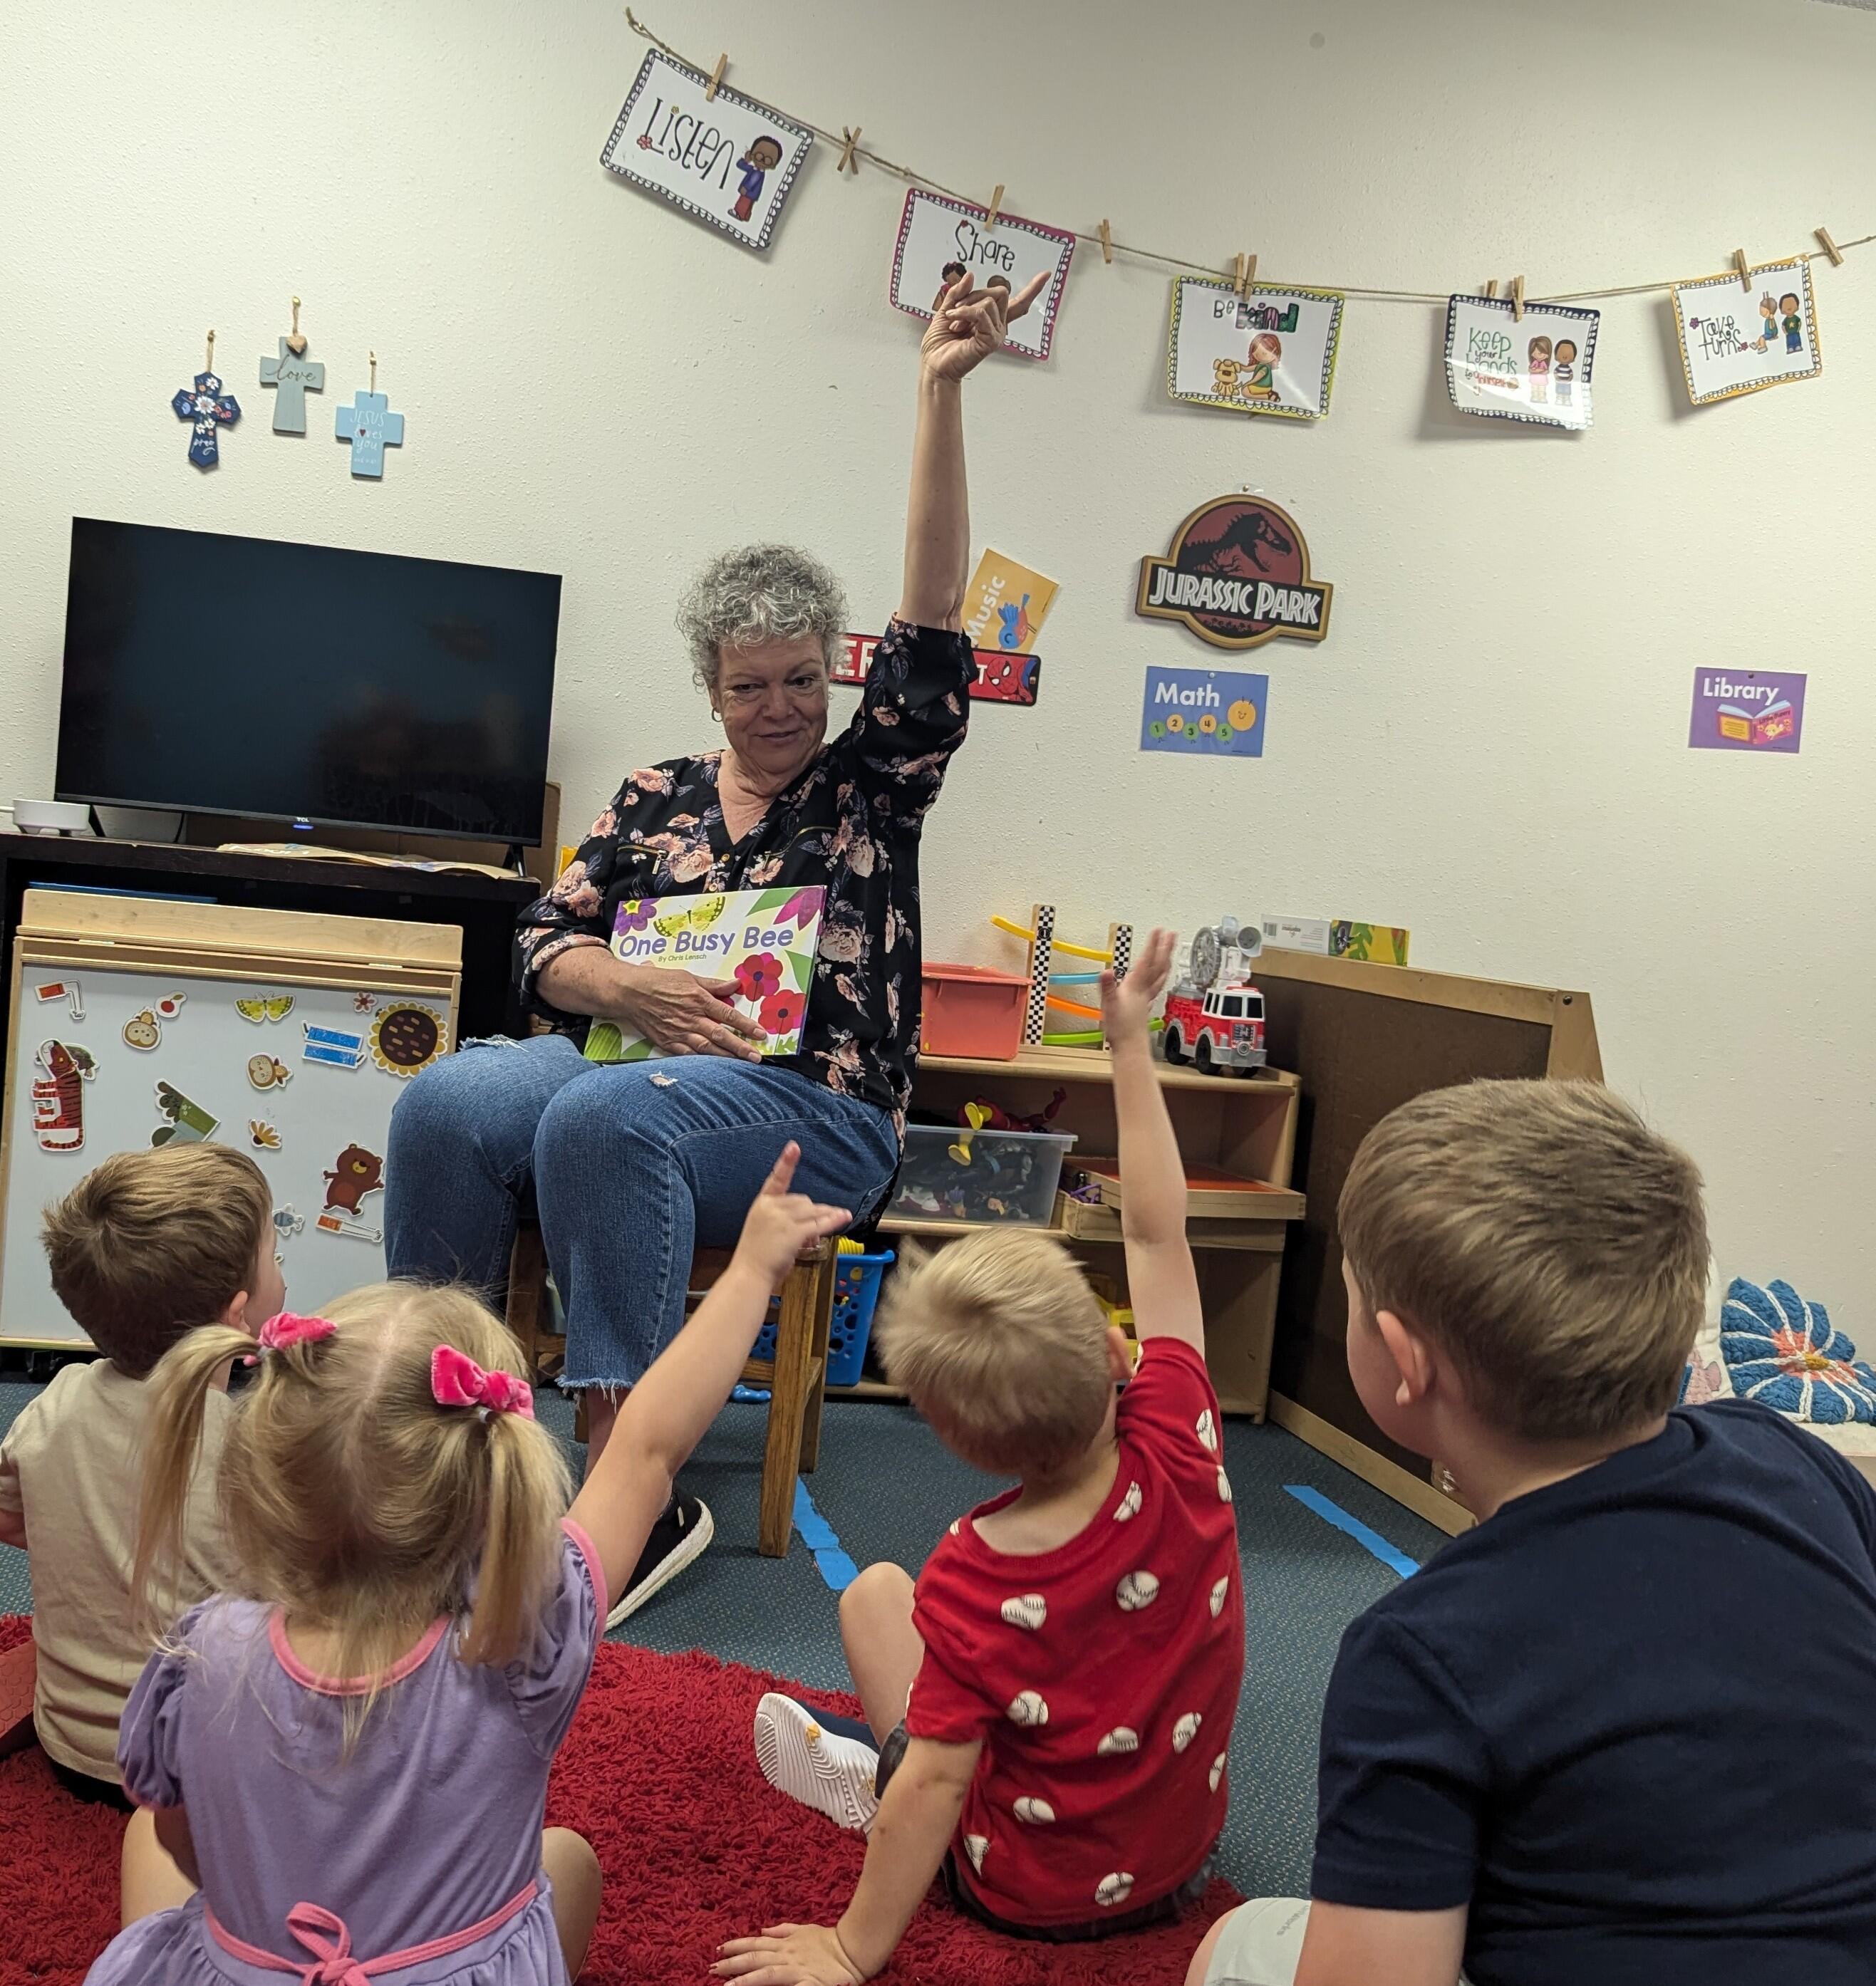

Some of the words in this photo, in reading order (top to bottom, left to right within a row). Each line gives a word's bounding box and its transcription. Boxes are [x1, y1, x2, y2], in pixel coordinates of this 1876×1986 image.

[638, 97, 735, 190] Listen
[955, 219, 1015, 272] Share
[1213, 299, 1235, 319] Be
[1235, 302, 1300, 333] kind
[1696, 315, 1735, 343] Take
[1468, 327, 1512, 359] Keep
[1475, 350, 1498, 363] your
[356, 439, 378, 454] you
[965, 575, 1006, 645] Music
[1149, 567, 1254, 615] JURASSIC
[1254, 581, 1321, 625] PARK
[1154, 682, 1221, 707] Math
[1702, 677, 1780, 706] Library
[1154, 724, 1160, 733] 1
[1171, 719, 1178, 727] 2
[1188, 727, 1194, 736] 3
[1203, 719, 1211, 728] 4
[1221, 728, 1228, 737] 5
[618, 935, 668, 957] One
[675, 931, 736, 955] Busy
[743, 926, 794, 949] Bee
